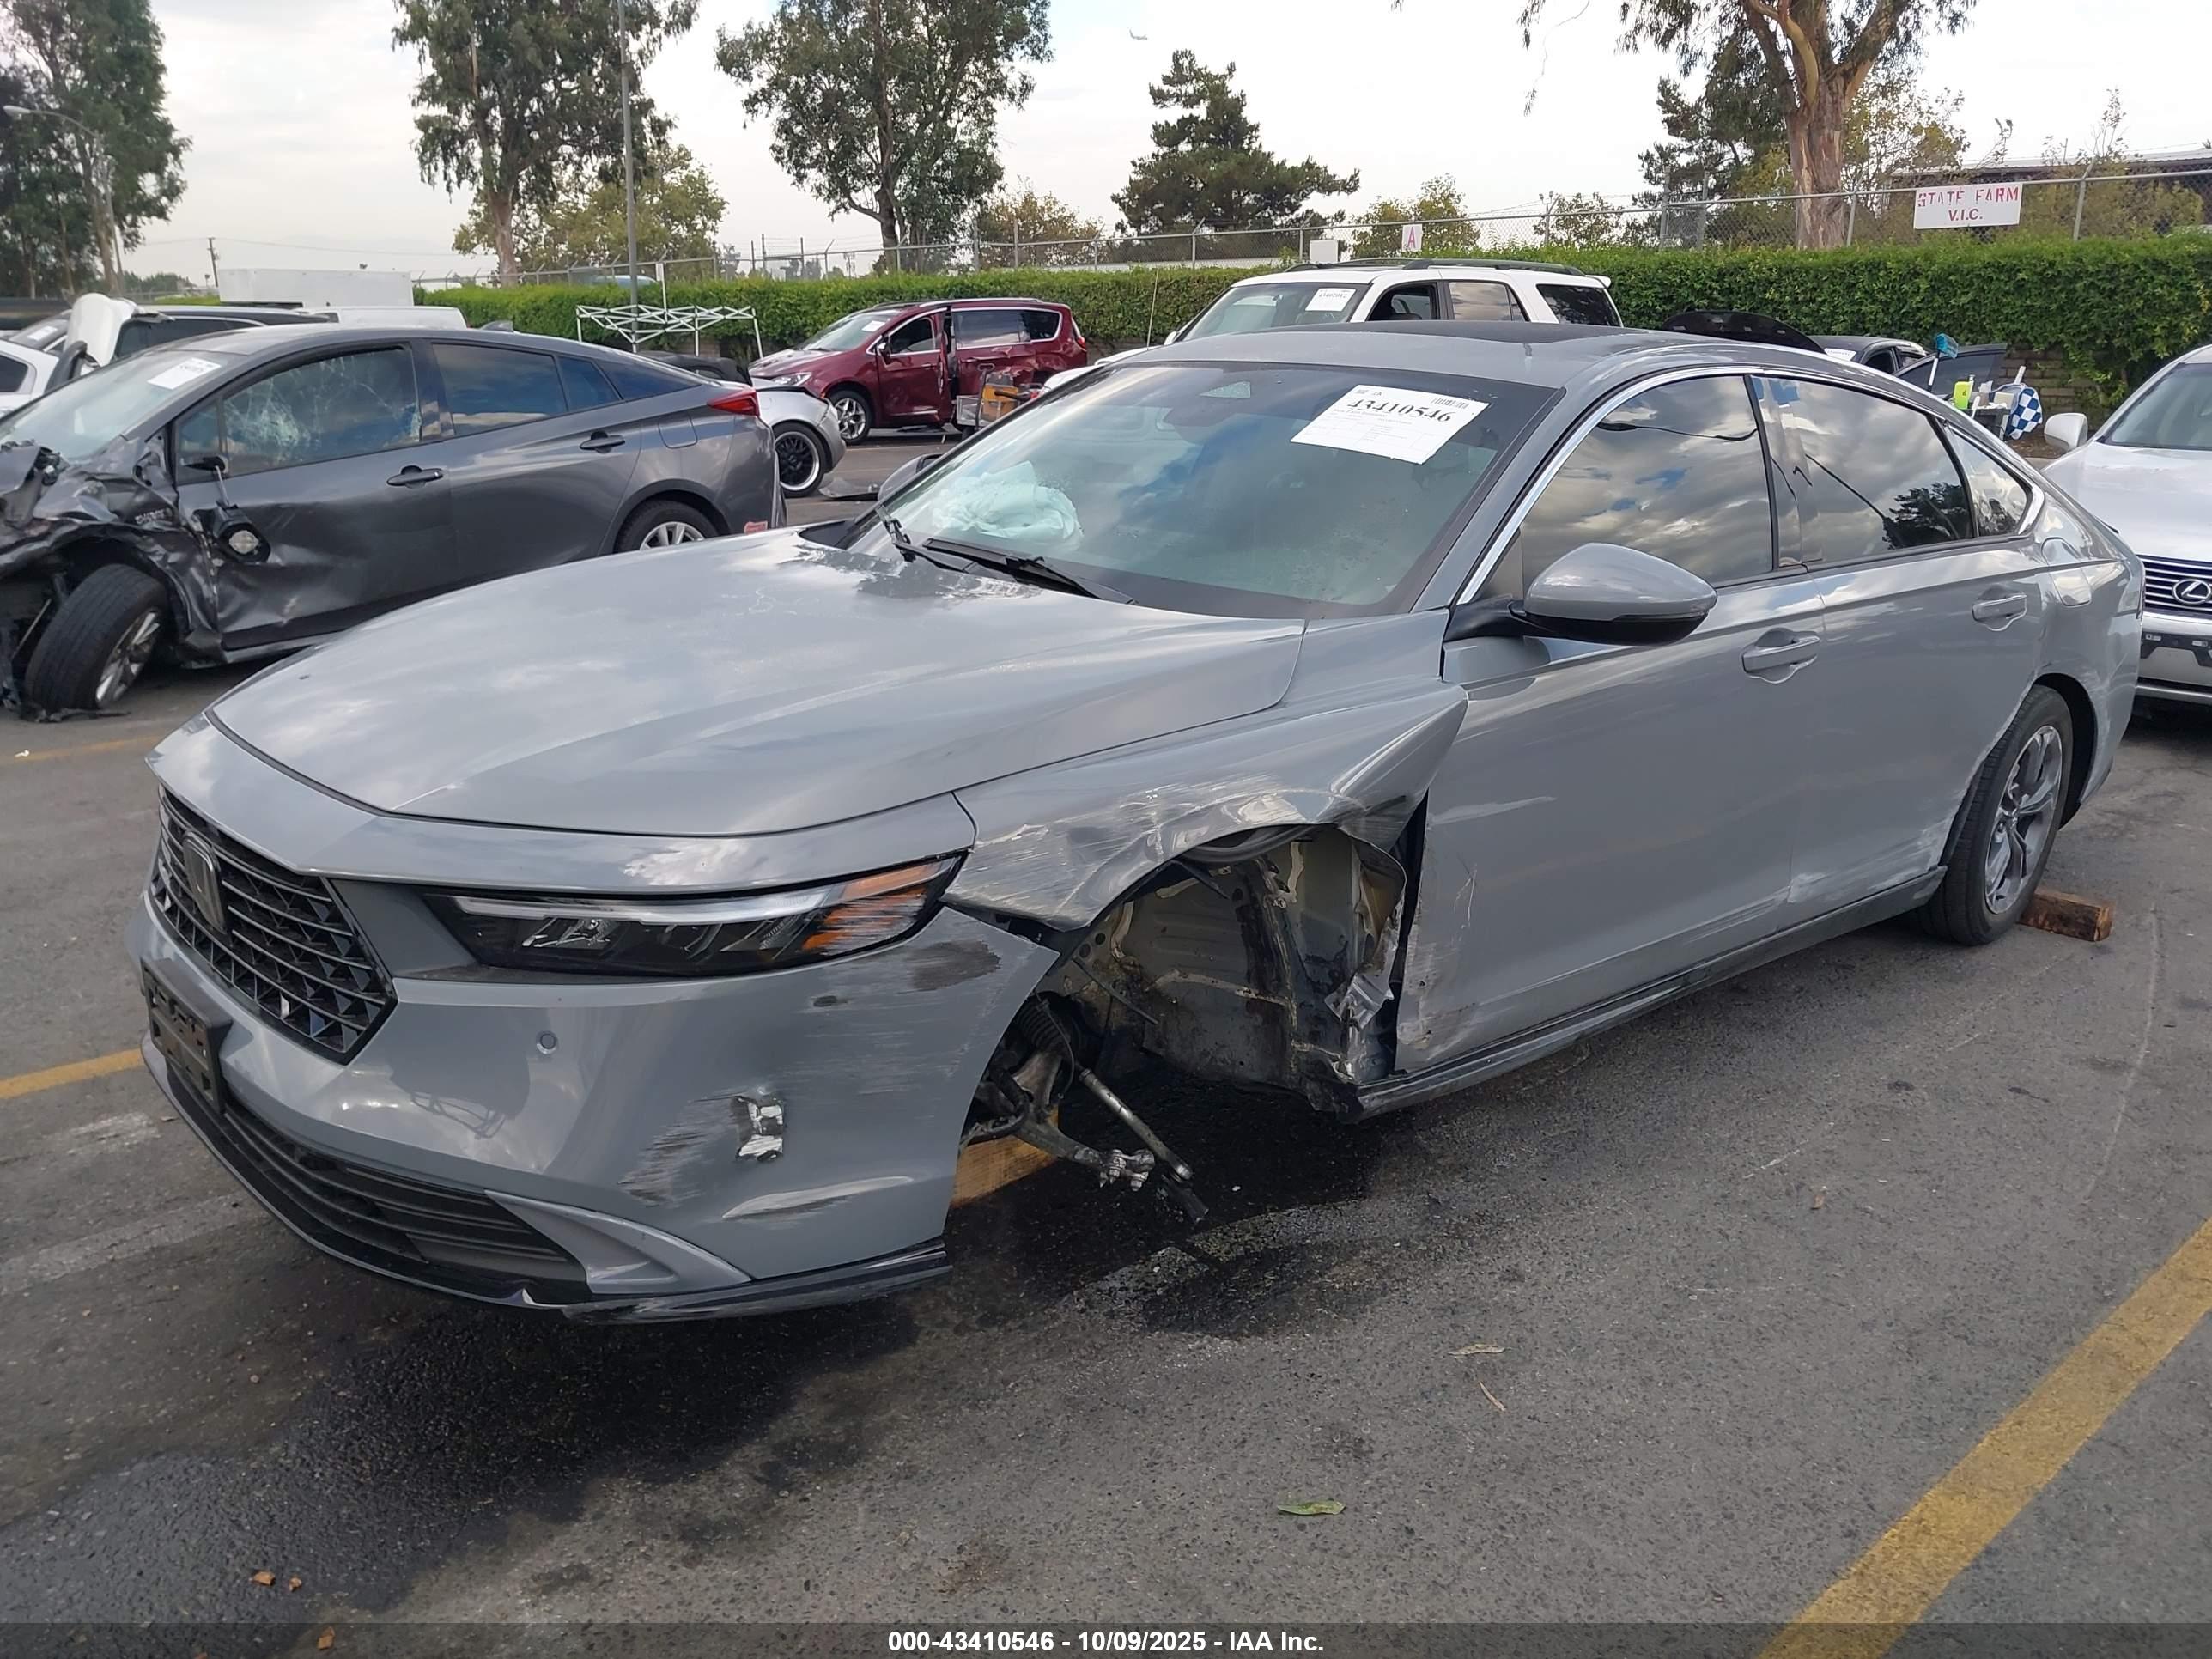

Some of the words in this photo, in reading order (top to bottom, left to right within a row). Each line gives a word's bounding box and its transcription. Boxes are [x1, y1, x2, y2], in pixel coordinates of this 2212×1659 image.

[1917, 190, 1965, 207] STATE
[1975, 186, 2019, 204] FARM
[1948, 208, 1983, 222] V.I.C.
[1407, 226, 1416, 249] A
[1346, 398, 1453, 422] 43410546
